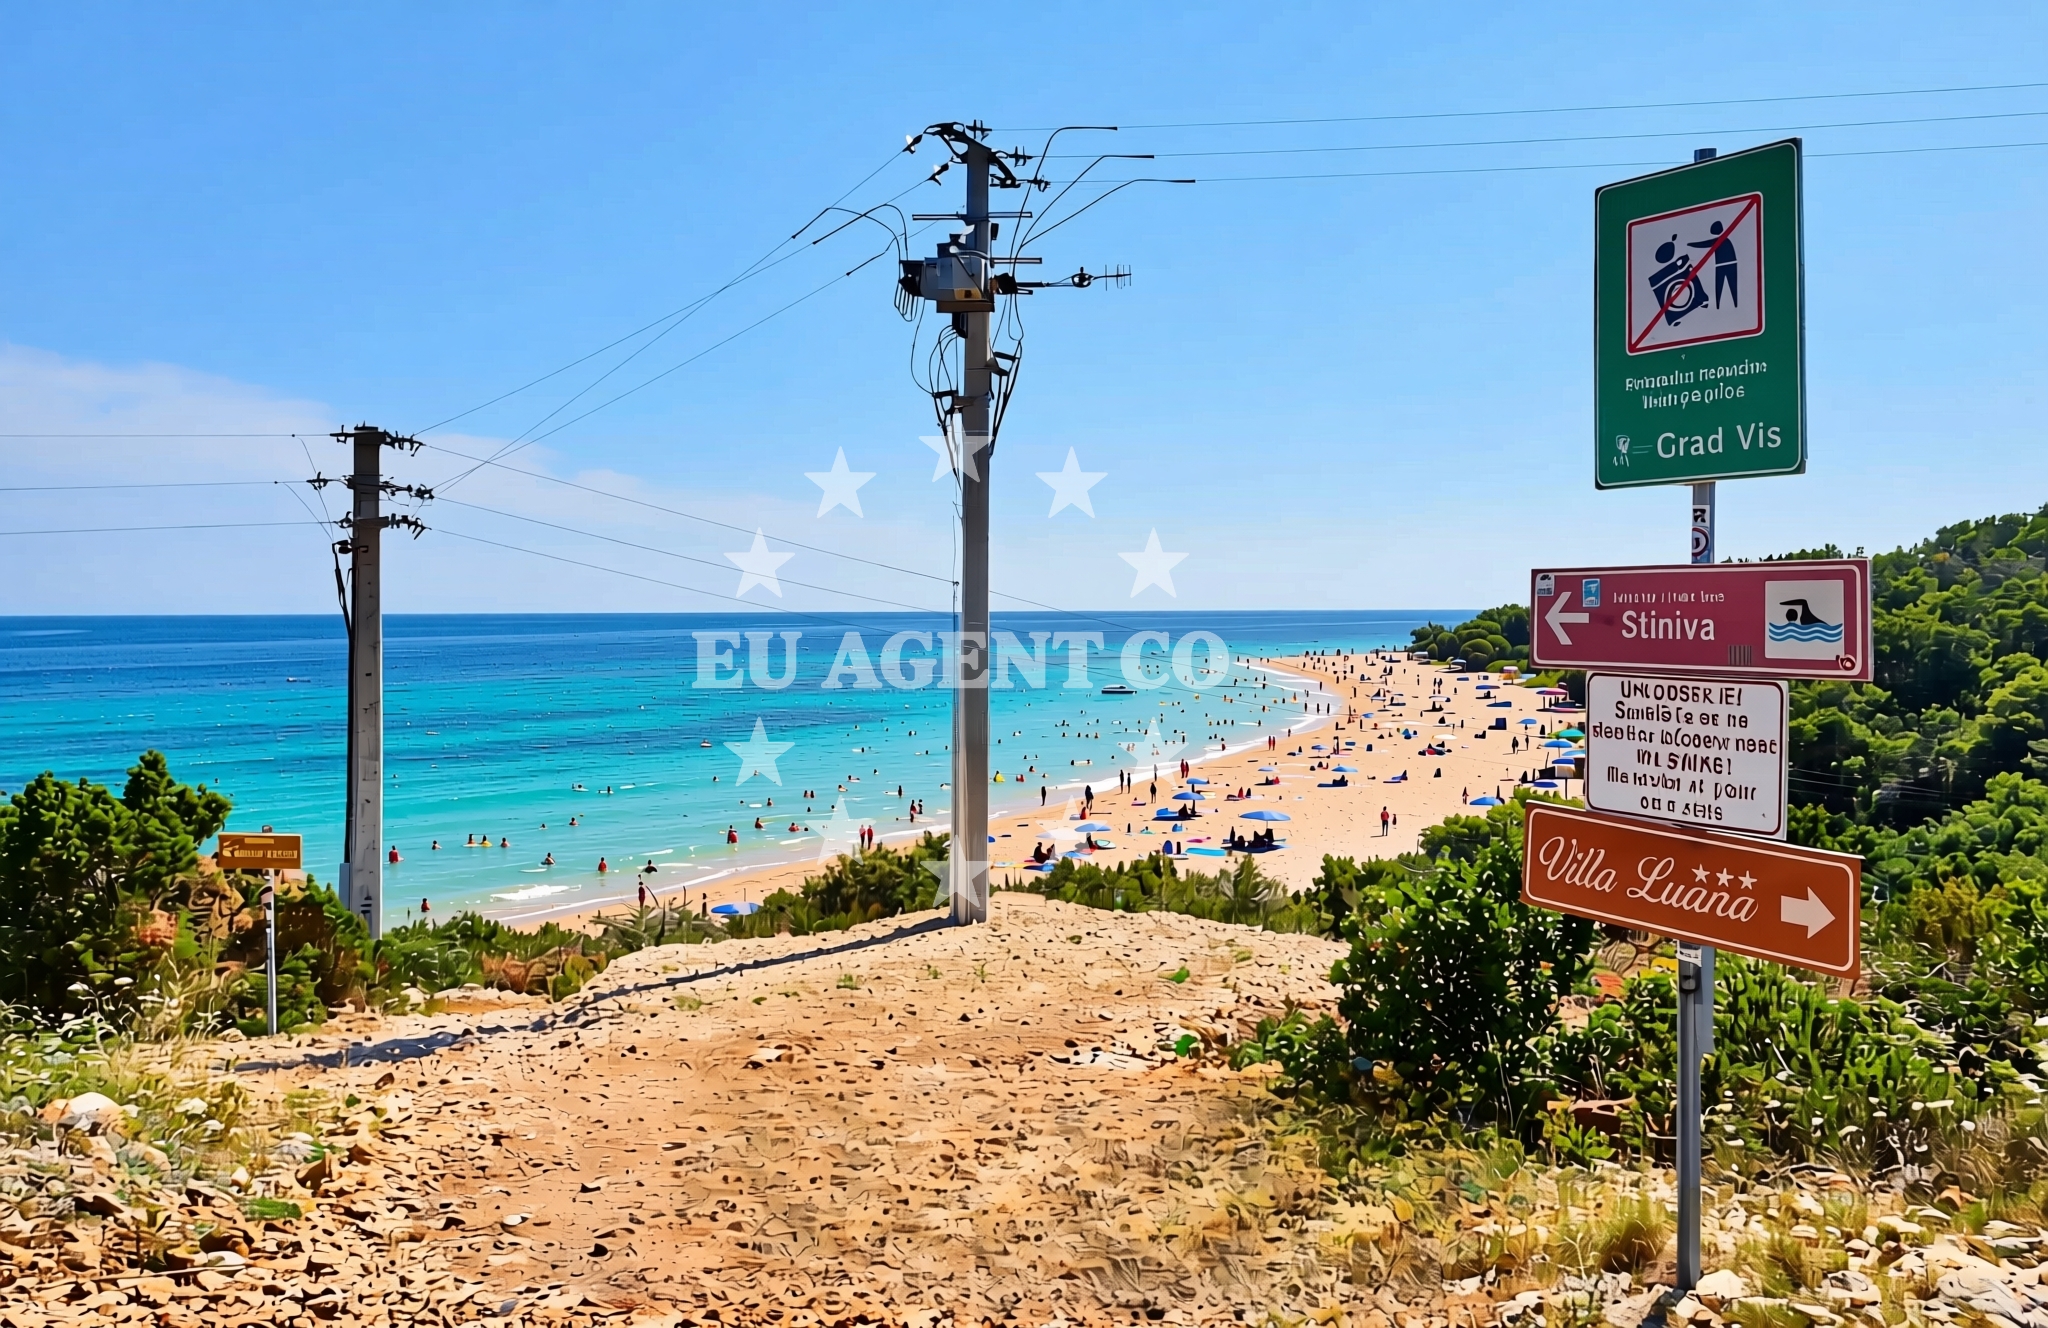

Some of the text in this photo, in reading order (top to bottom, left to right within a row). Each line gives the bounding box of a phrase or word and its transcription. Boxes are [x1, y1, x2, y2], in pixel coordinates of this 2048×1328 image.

[1656, 421, 1782, 459] Grad Vis
[1621, 609, 1715, 641] Stiniva
[1539, 836, 1758, 922] Villa Luana
